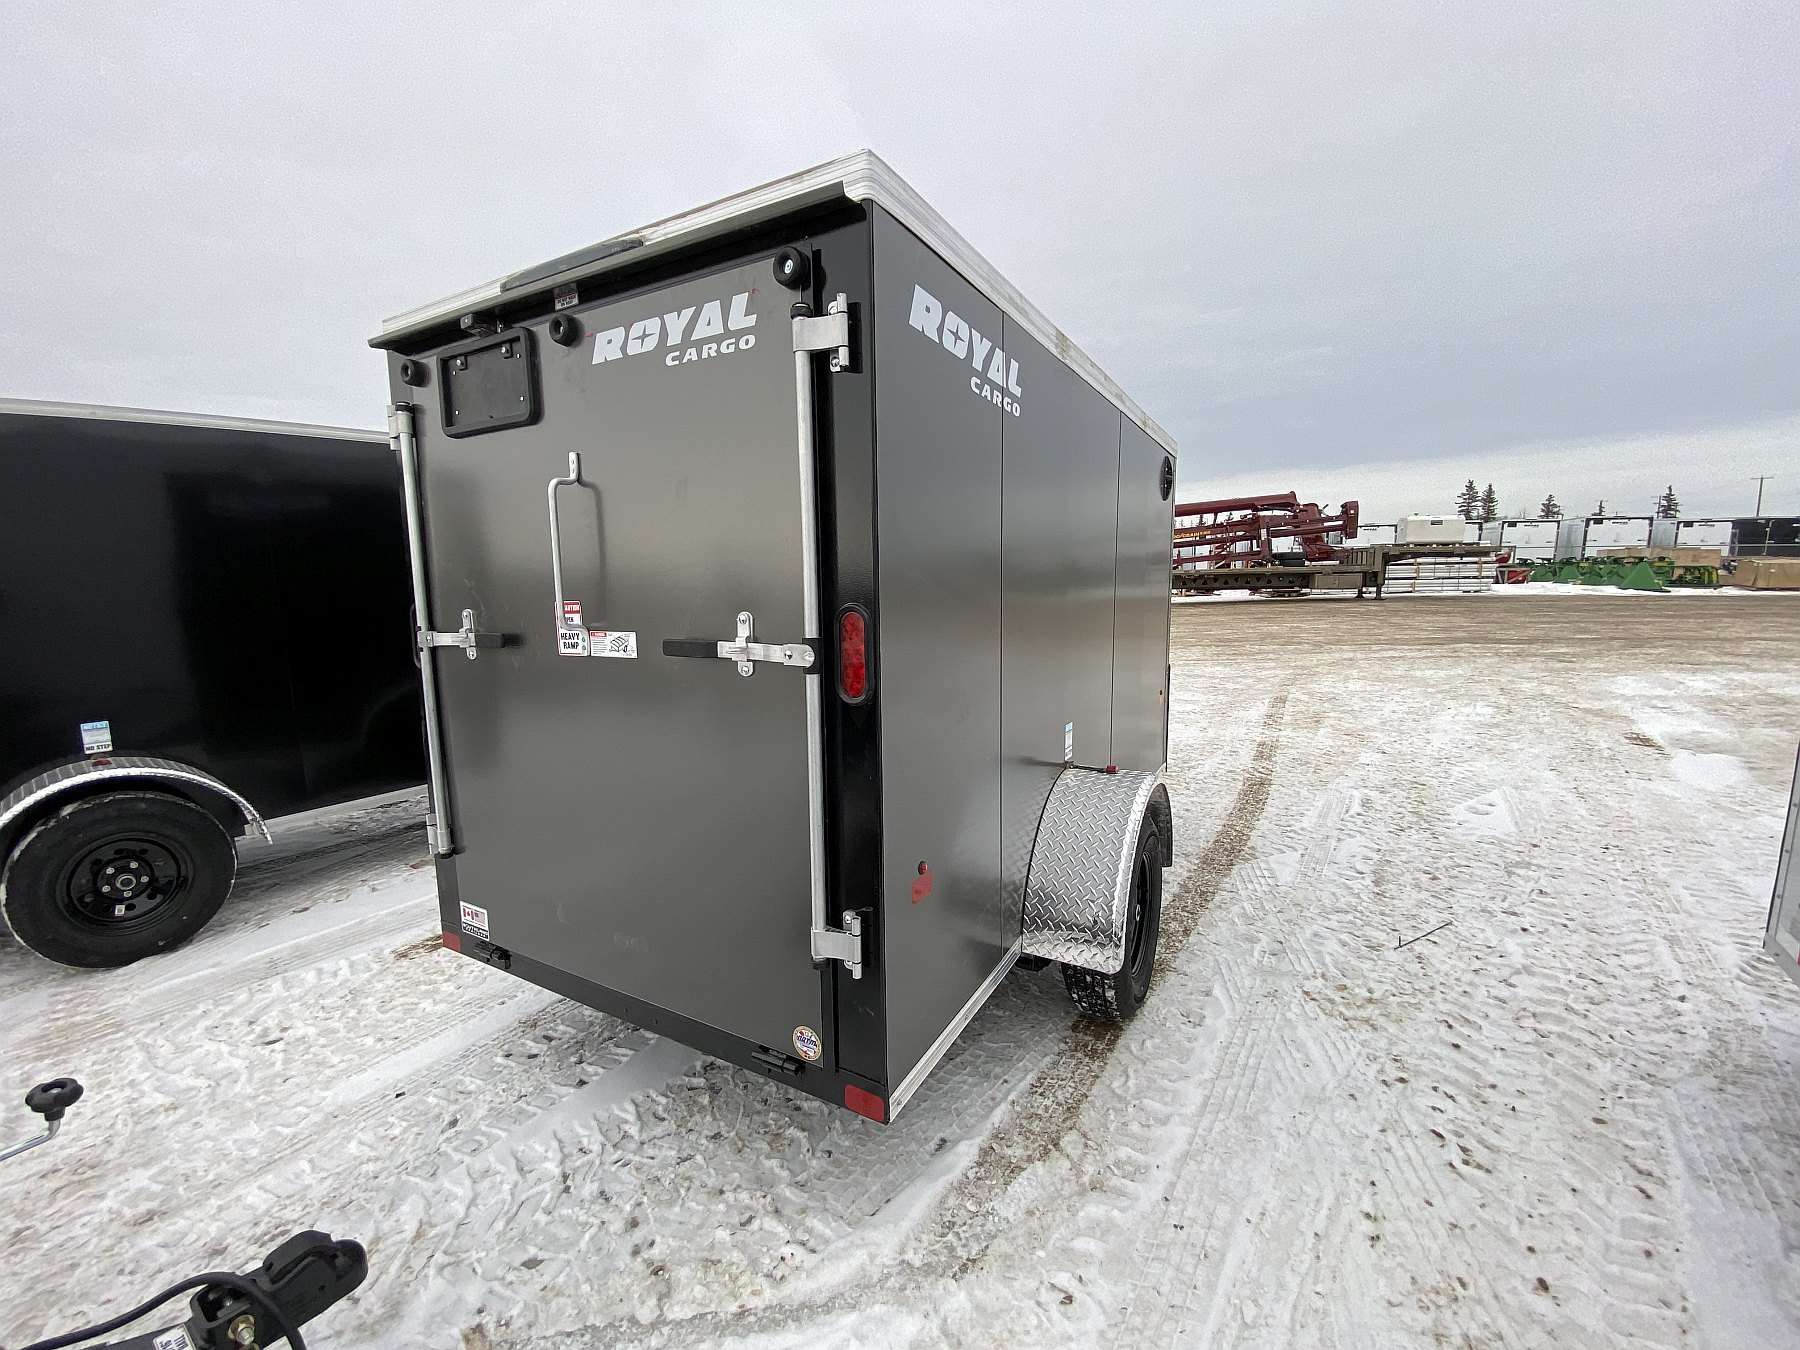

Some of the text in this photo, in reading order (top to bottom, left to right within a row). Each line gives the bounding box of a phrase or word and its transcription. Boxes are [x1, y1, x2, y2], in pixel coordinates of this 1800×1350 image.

[592, 292, 757, 365] ROYAL
[909, 284, 1022, 398] ROYAL
[665, 334, 756, 367] CARGO
[970, 376, 1021, 417] CARGO
[560, 632, 580, 641] HEAVY
[563, 641, 579, 650] RAMP
